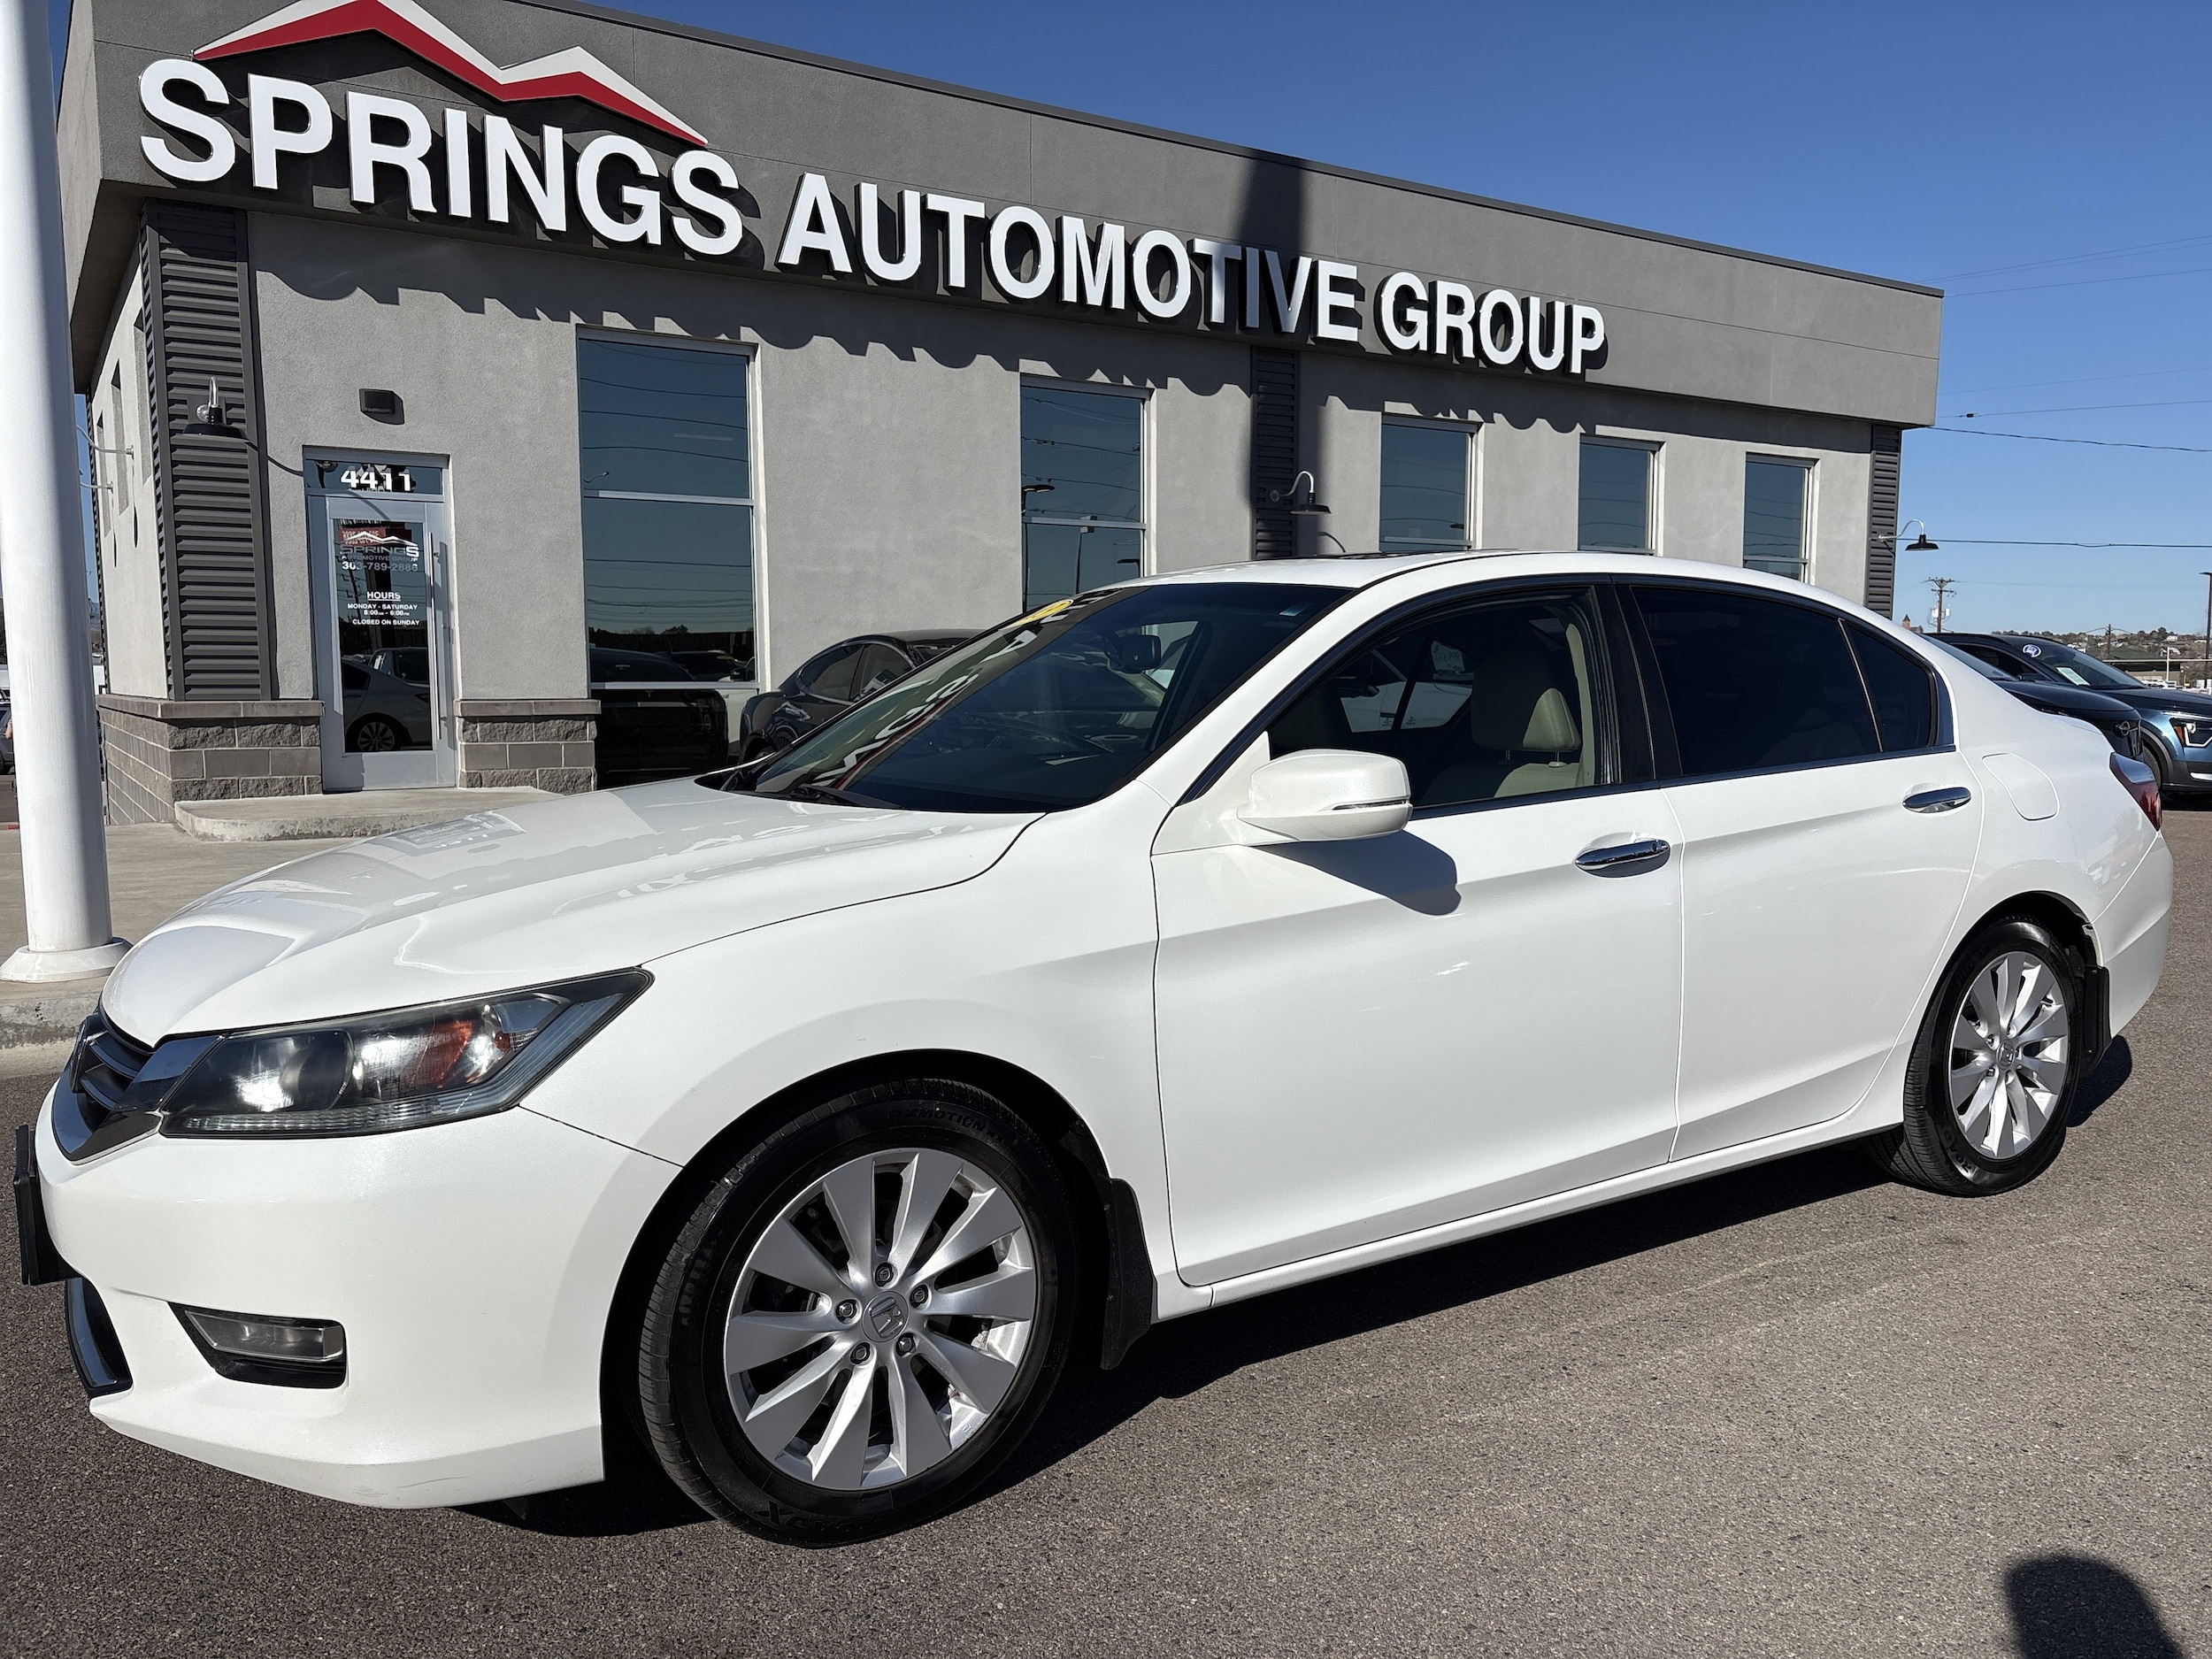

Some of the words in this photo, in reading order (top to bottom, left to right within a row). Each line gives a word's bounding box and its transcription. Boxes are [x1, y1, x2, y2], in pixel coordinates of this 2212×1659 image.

[139, 58, 743, 257] SPRINGS
[778, 172, 1359, 342] AUTOMOTIVE
[1378, 271, 1606, 374] GROUP
[341, 466, 411, 491] 4411
[340, 545, 419, 557] SPRINGS
[366, 591, 402, 600] HOURS
